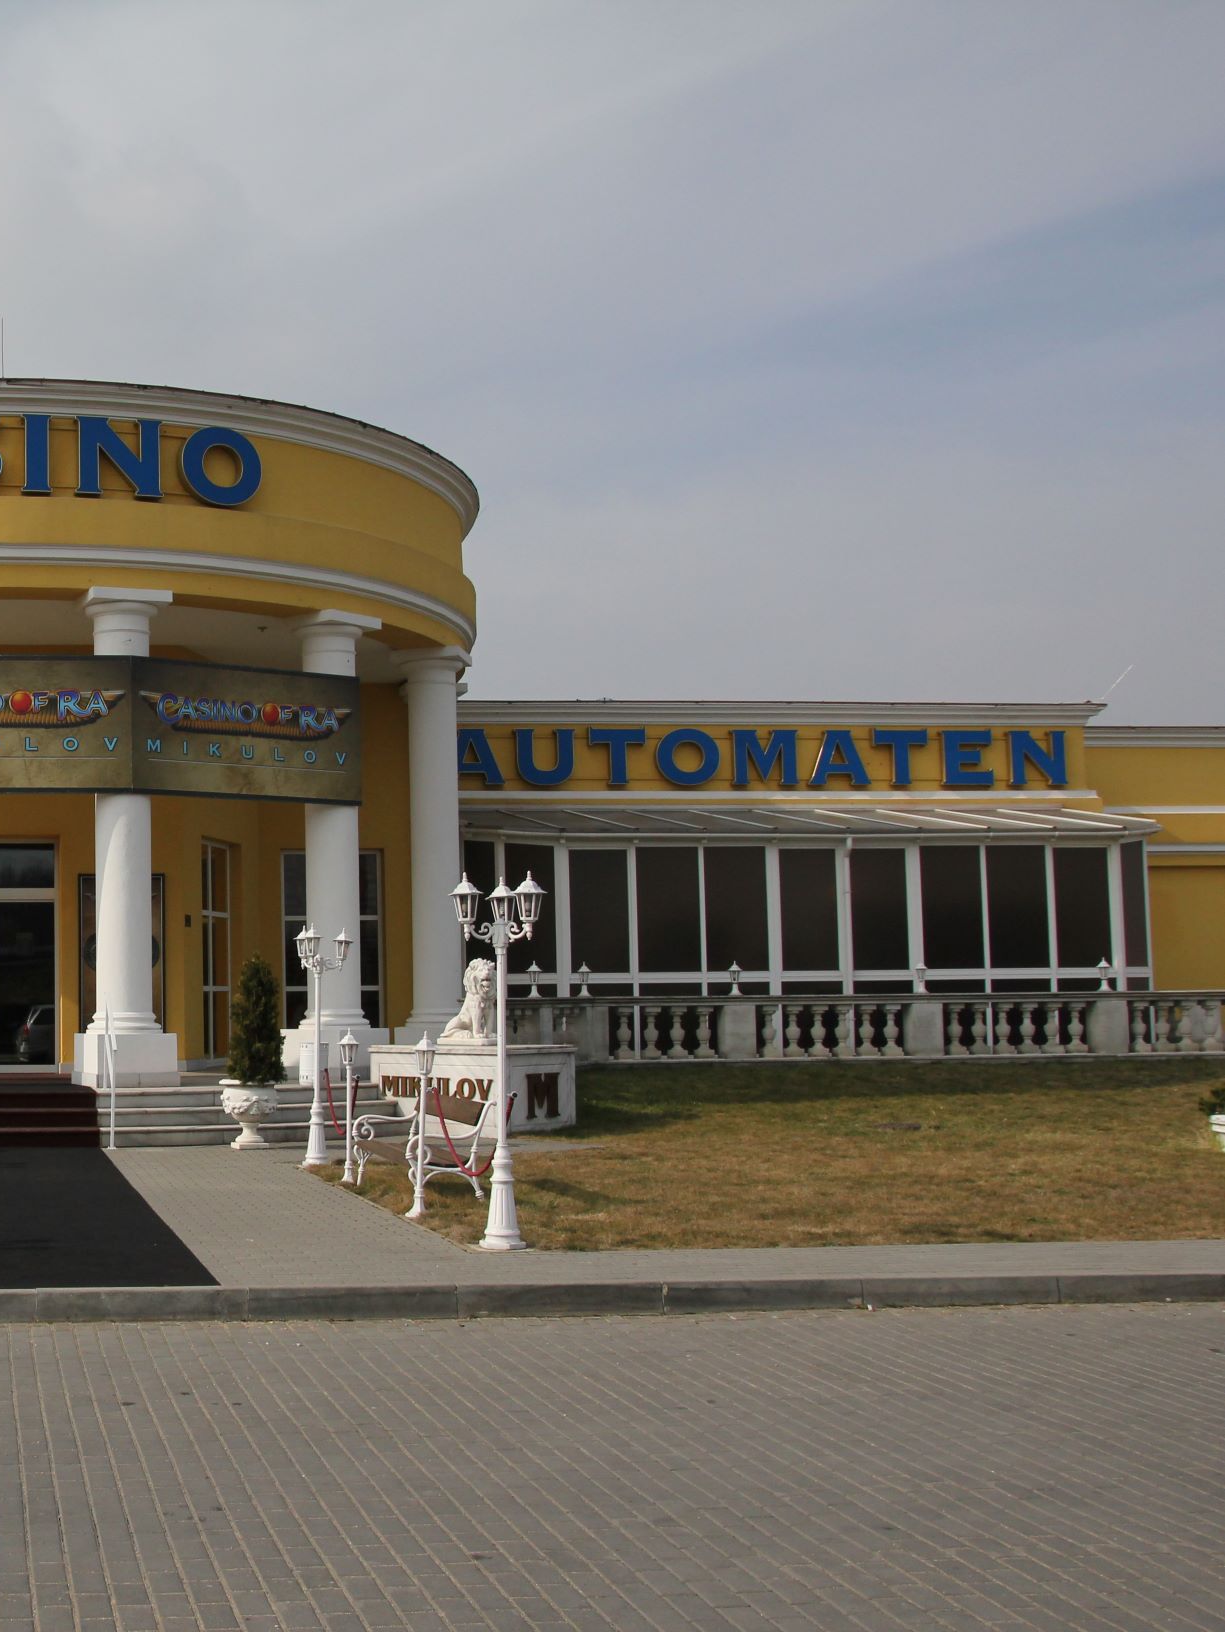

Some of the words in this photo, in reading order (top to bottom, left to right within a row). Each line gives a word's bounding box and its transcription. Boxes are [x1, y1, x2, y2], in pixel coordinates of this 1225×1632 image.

[9, 689, 49, 715] OF
[56, 689, 109, 721] RA
[156, 692, 258, 724] CASINO
[260, 702, 293, 725] OF
[298, 705, 340, 733] RA
[147, 738, 347, 765] MIKULOV
[457, 727, 1068, 786] AUTOMATEN
[526, 1072, 560, 1120] M
